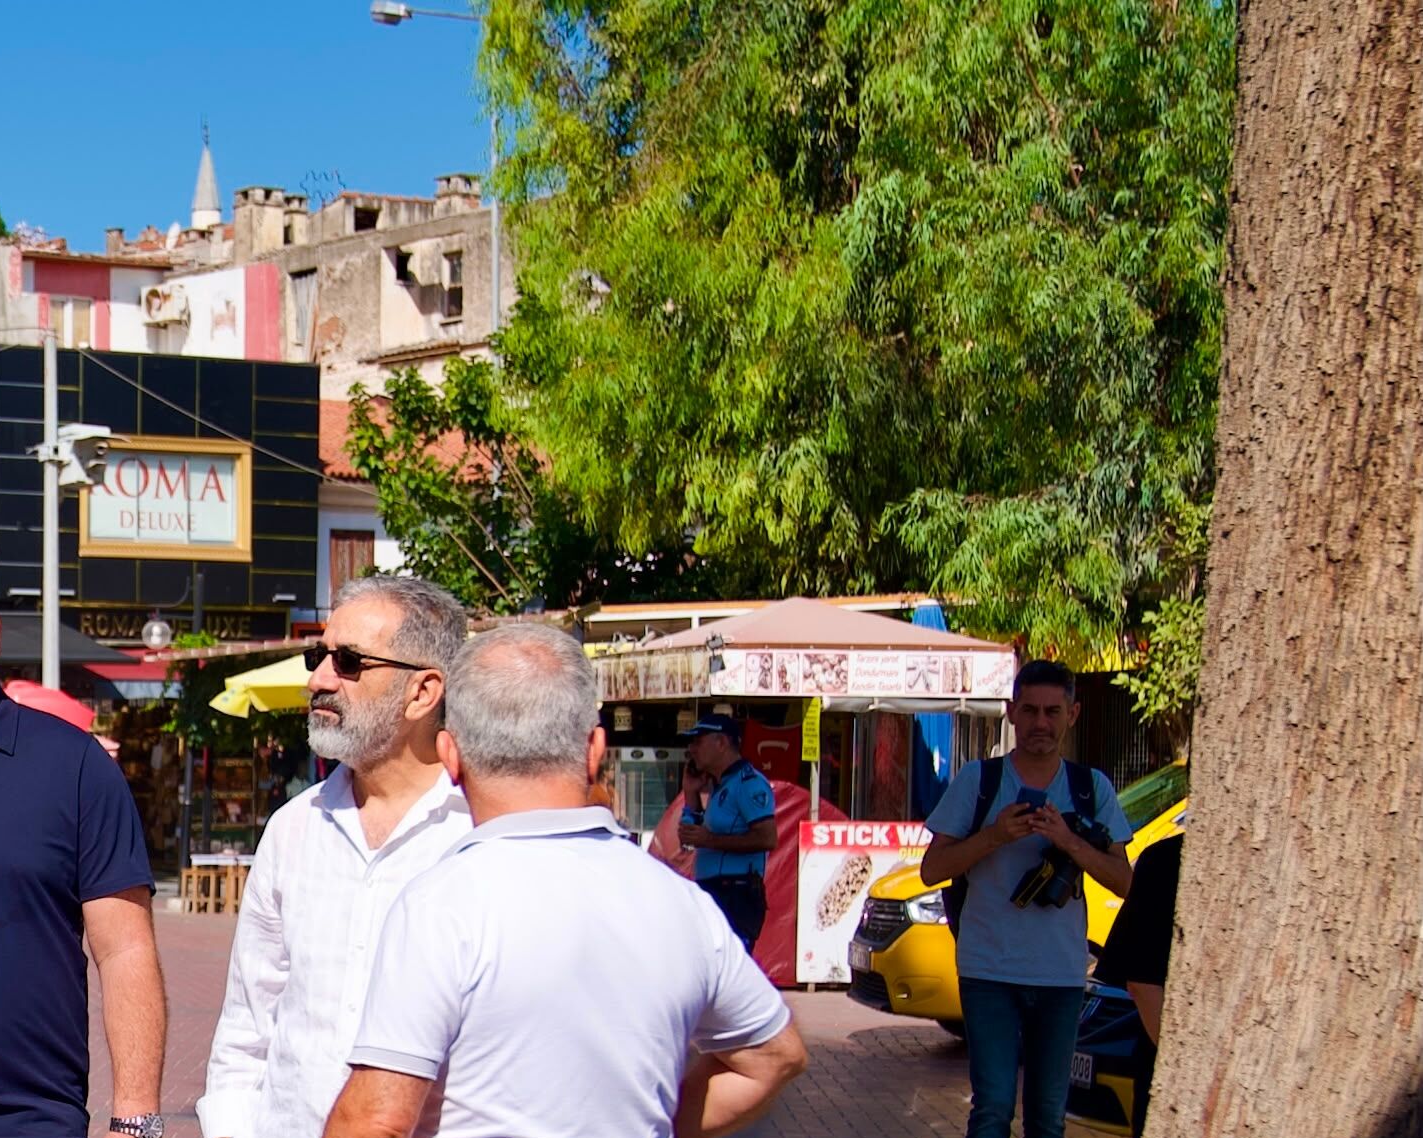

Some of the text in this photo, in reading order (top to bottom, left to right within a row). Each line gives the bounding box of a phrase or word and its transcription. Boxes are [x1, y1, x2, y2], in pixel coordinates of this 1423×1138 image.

[119, 510, 197, 532] DELUXE
[80, 610, 252, 640] ROMA DEUXE
[812, 824, 891, 846] STICK
